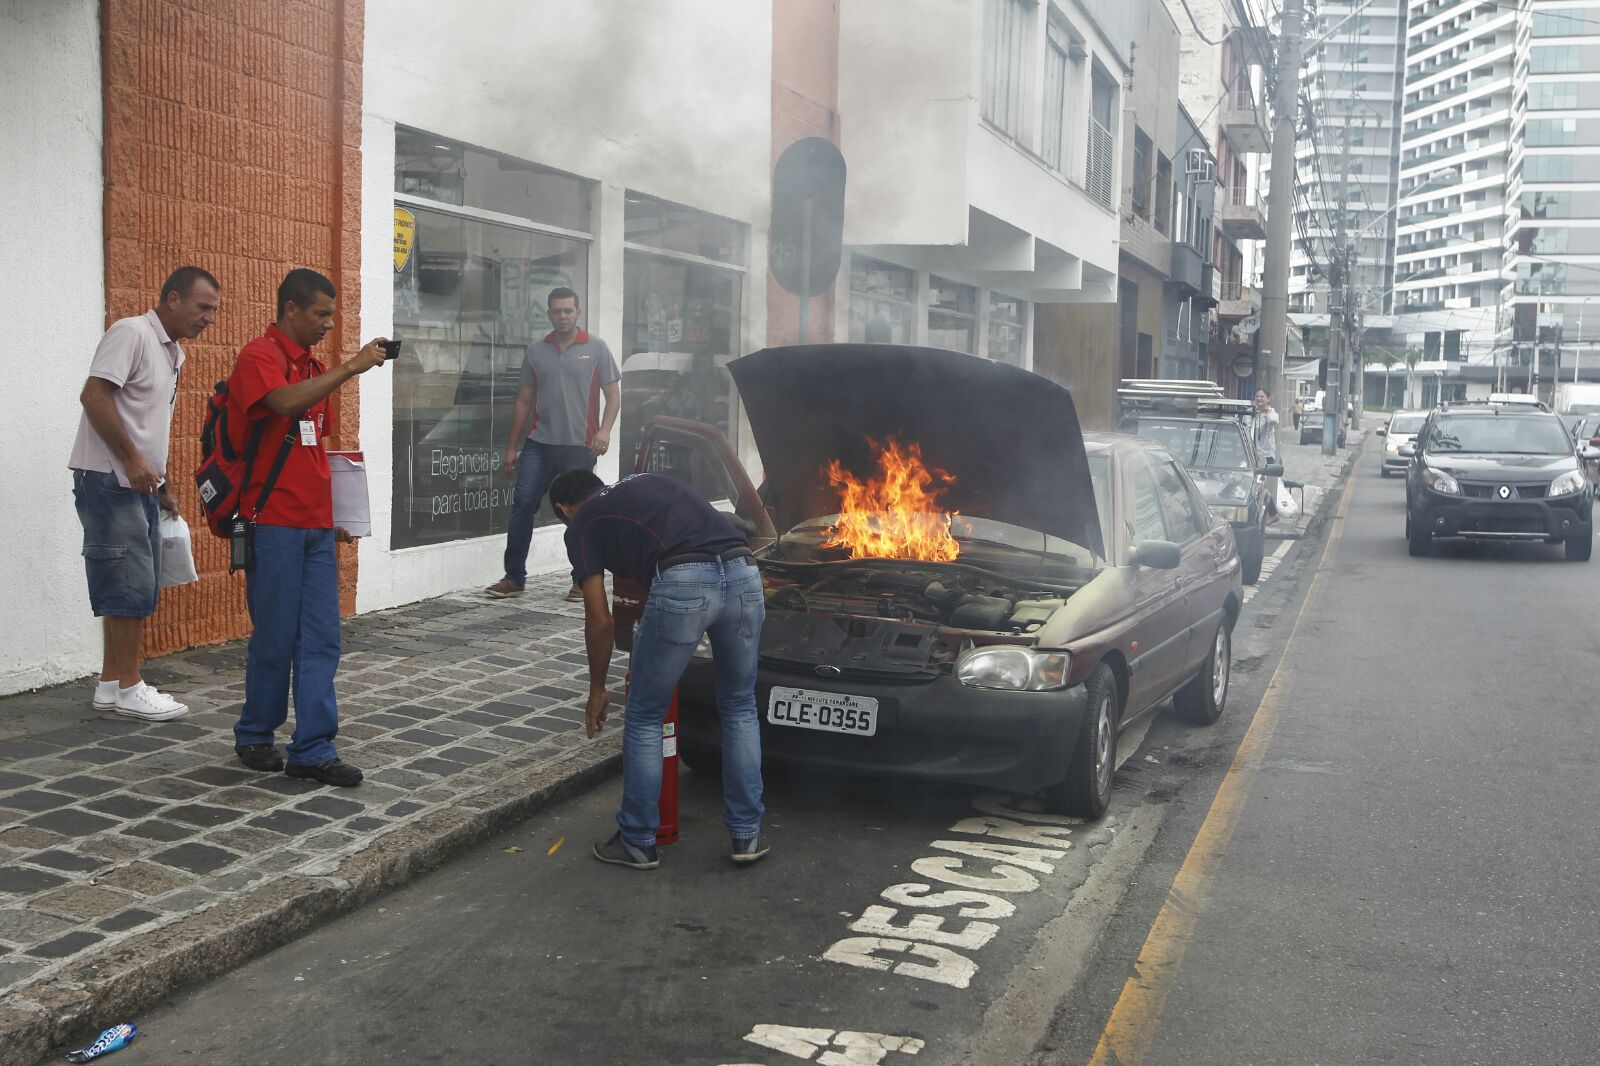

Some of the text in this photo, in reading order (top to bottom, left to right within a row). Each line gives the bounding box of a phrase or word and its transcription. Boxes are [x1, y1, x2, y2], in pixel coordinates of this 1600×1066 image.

[432, 448, 500, 480] Elegância e
[432, 495, 461, 521] para
[464, 487, 488, 511] toda
[491, 488, 500, 507] a
